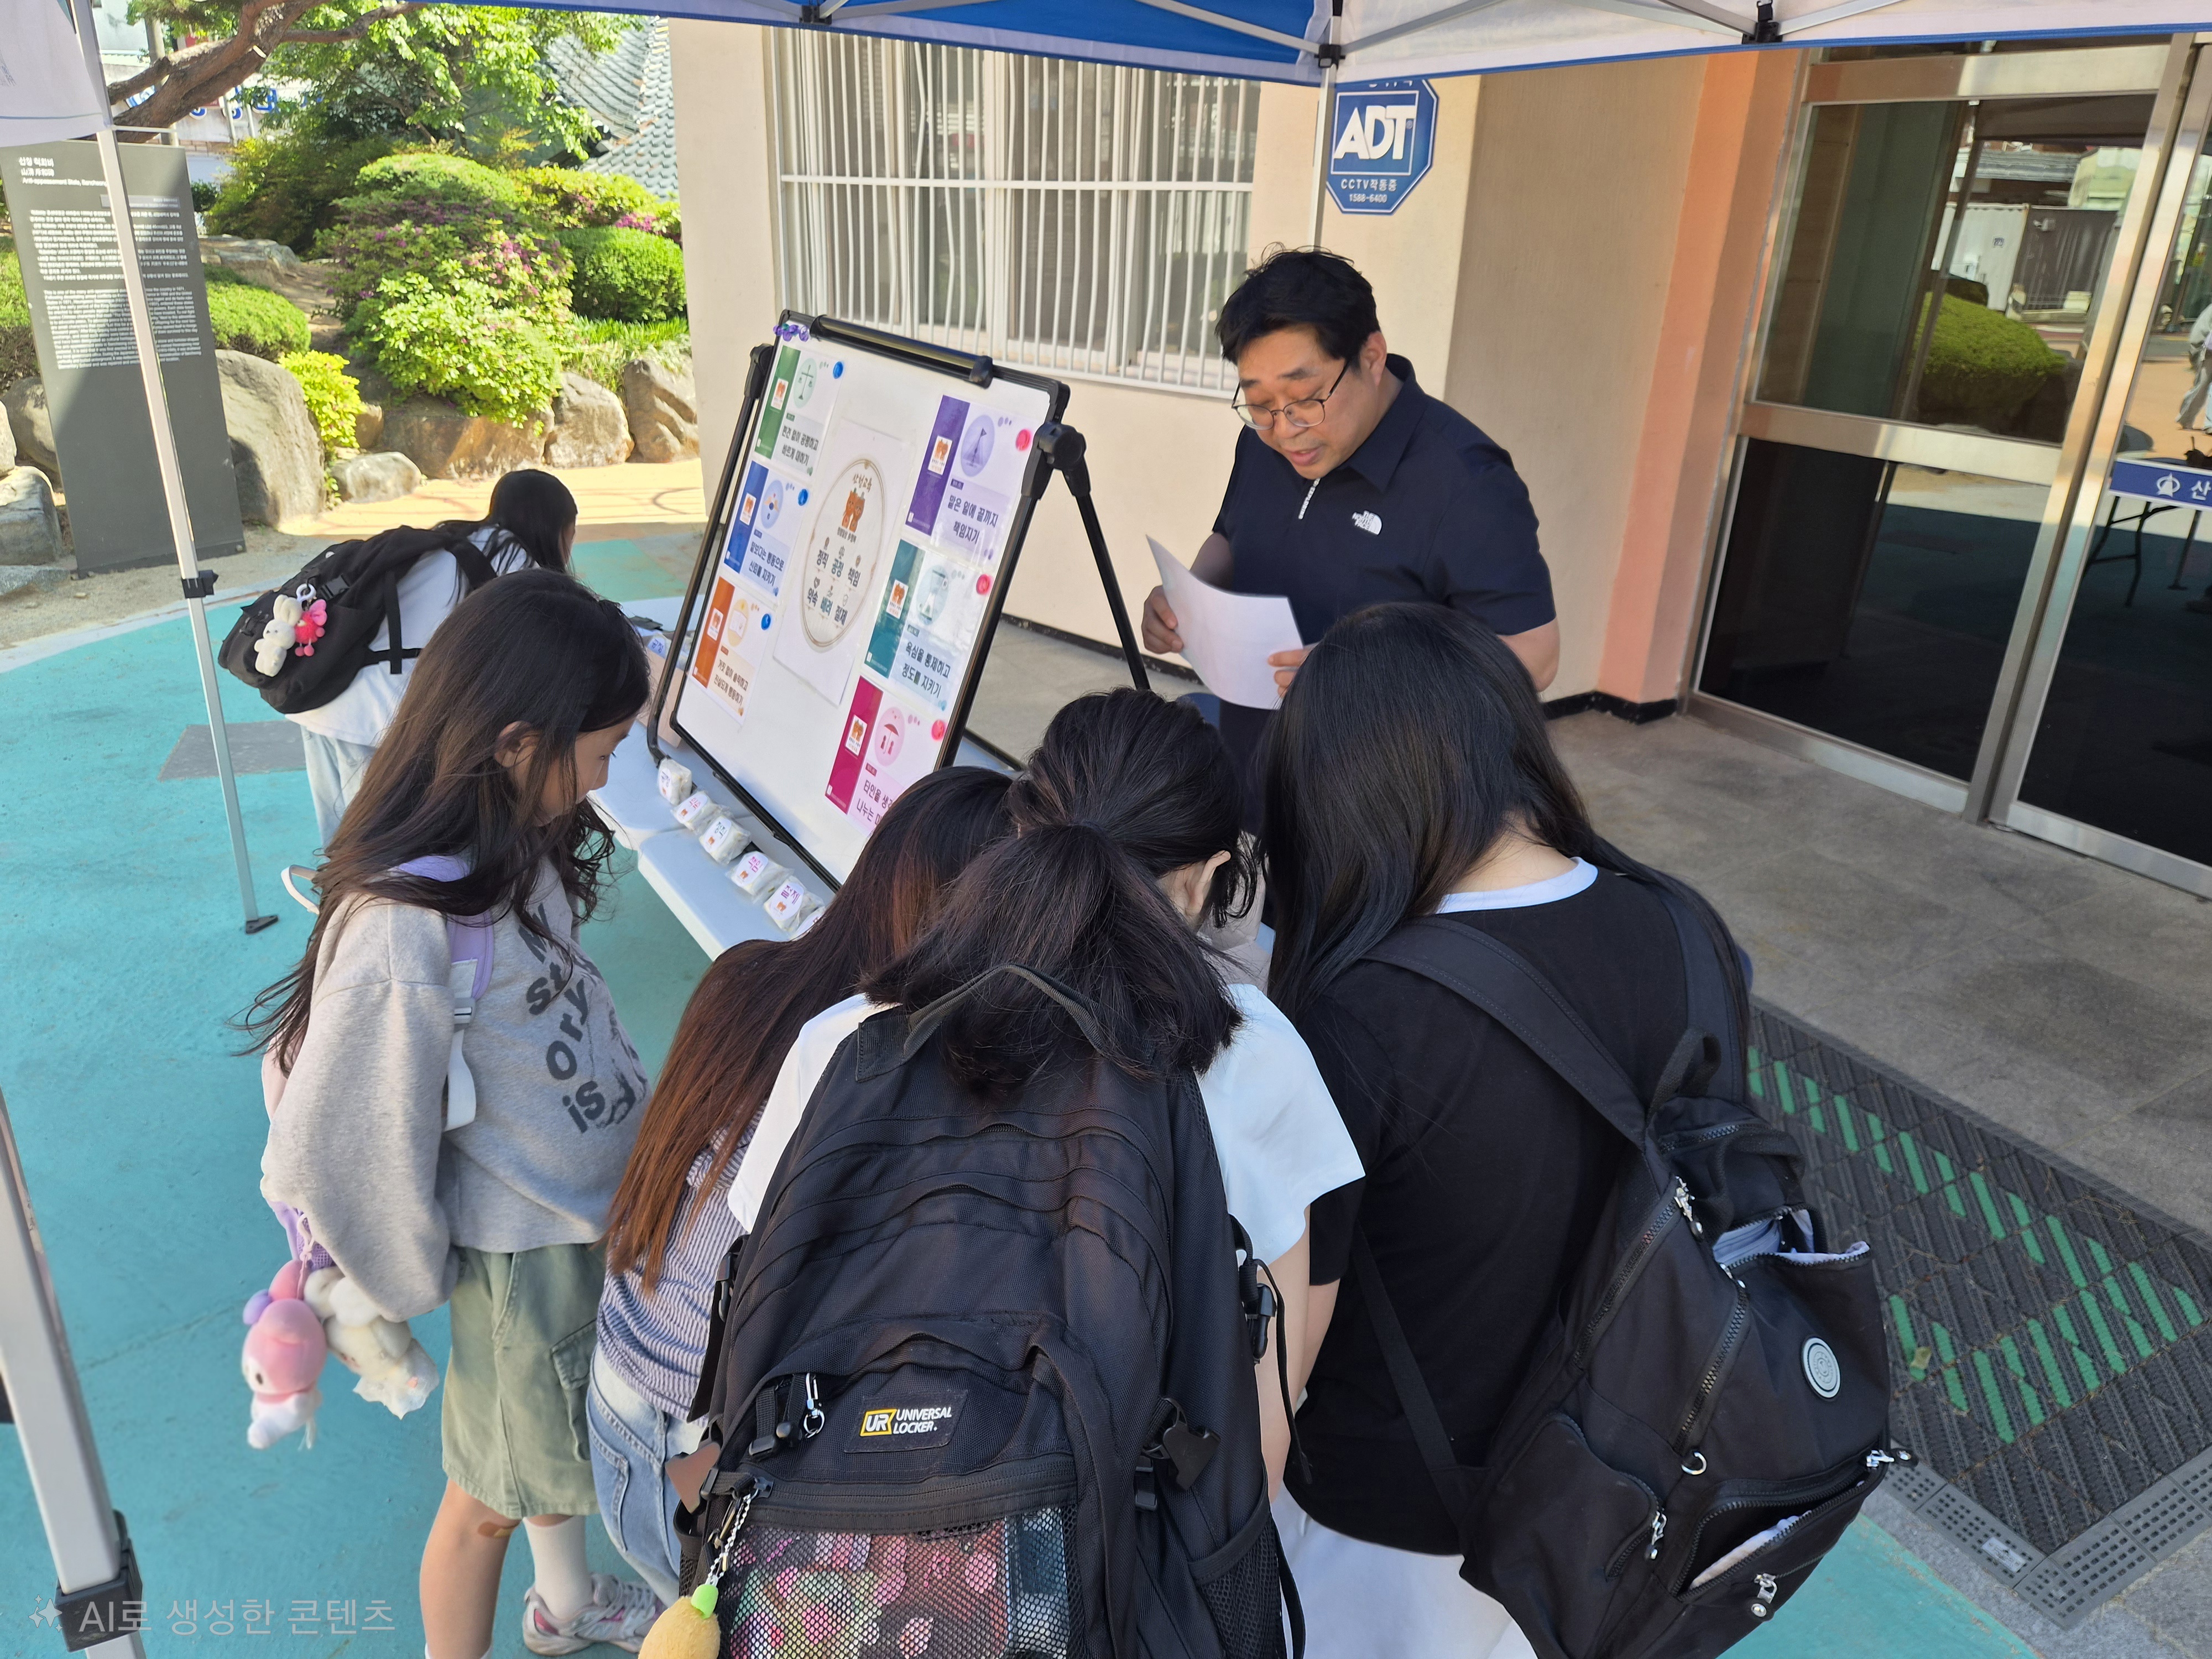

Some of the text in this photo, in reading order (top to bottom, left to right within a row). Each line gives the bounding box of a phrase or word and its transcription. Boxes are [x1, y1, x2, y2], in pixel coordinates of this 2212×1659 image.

[1333, 105, 1417, 159] ADT
[1340, 179, 1397, 192] CCTV작동중
[1349, 194, 1388, 204] 1588-6400
[782, 425, 819, 451] 편견 없이 공평하고
[782, 444, 795, 460] 바르게
[795, 450, 810, 466] 대하기
[2191, 480, 2211, 500] 산
[948, 494, 999, 528] 맡은 일에 끝까지
[953, 520, 980, 545] 책임지기
[750, 541, 785, 572] 말보다는 행동으로
[816, 549, 861, 587] 정직 공정 책임
[749, 560, 762, 578] 신뢰를
[762, 568, 776, 587] 지키기
[807, 587, 848, 626] 약속 배려 절제
[905, 641, 951, 679] 욕심을 통제하고
[718, 659, 749, 691] 거짓 없이 솔직하고
[902, 663, 921, 685] 정도를
[921, 675, 942, 699] 지키기
[714, 674, 729, 694] 진실되게
[728, 687, 744, 706] 행동하기
[863, 779, 881, 803] 타인을
[857, 797, 874, 822] 나누는
[714, 821, 727, 839] 정직
[748, 856, 763, 873] 책임
[780, 885, 801, 905] 절제
[546, 978, 588, 1081] ory
[865, 1407, 952, 1431] UR UNIVERSAL
